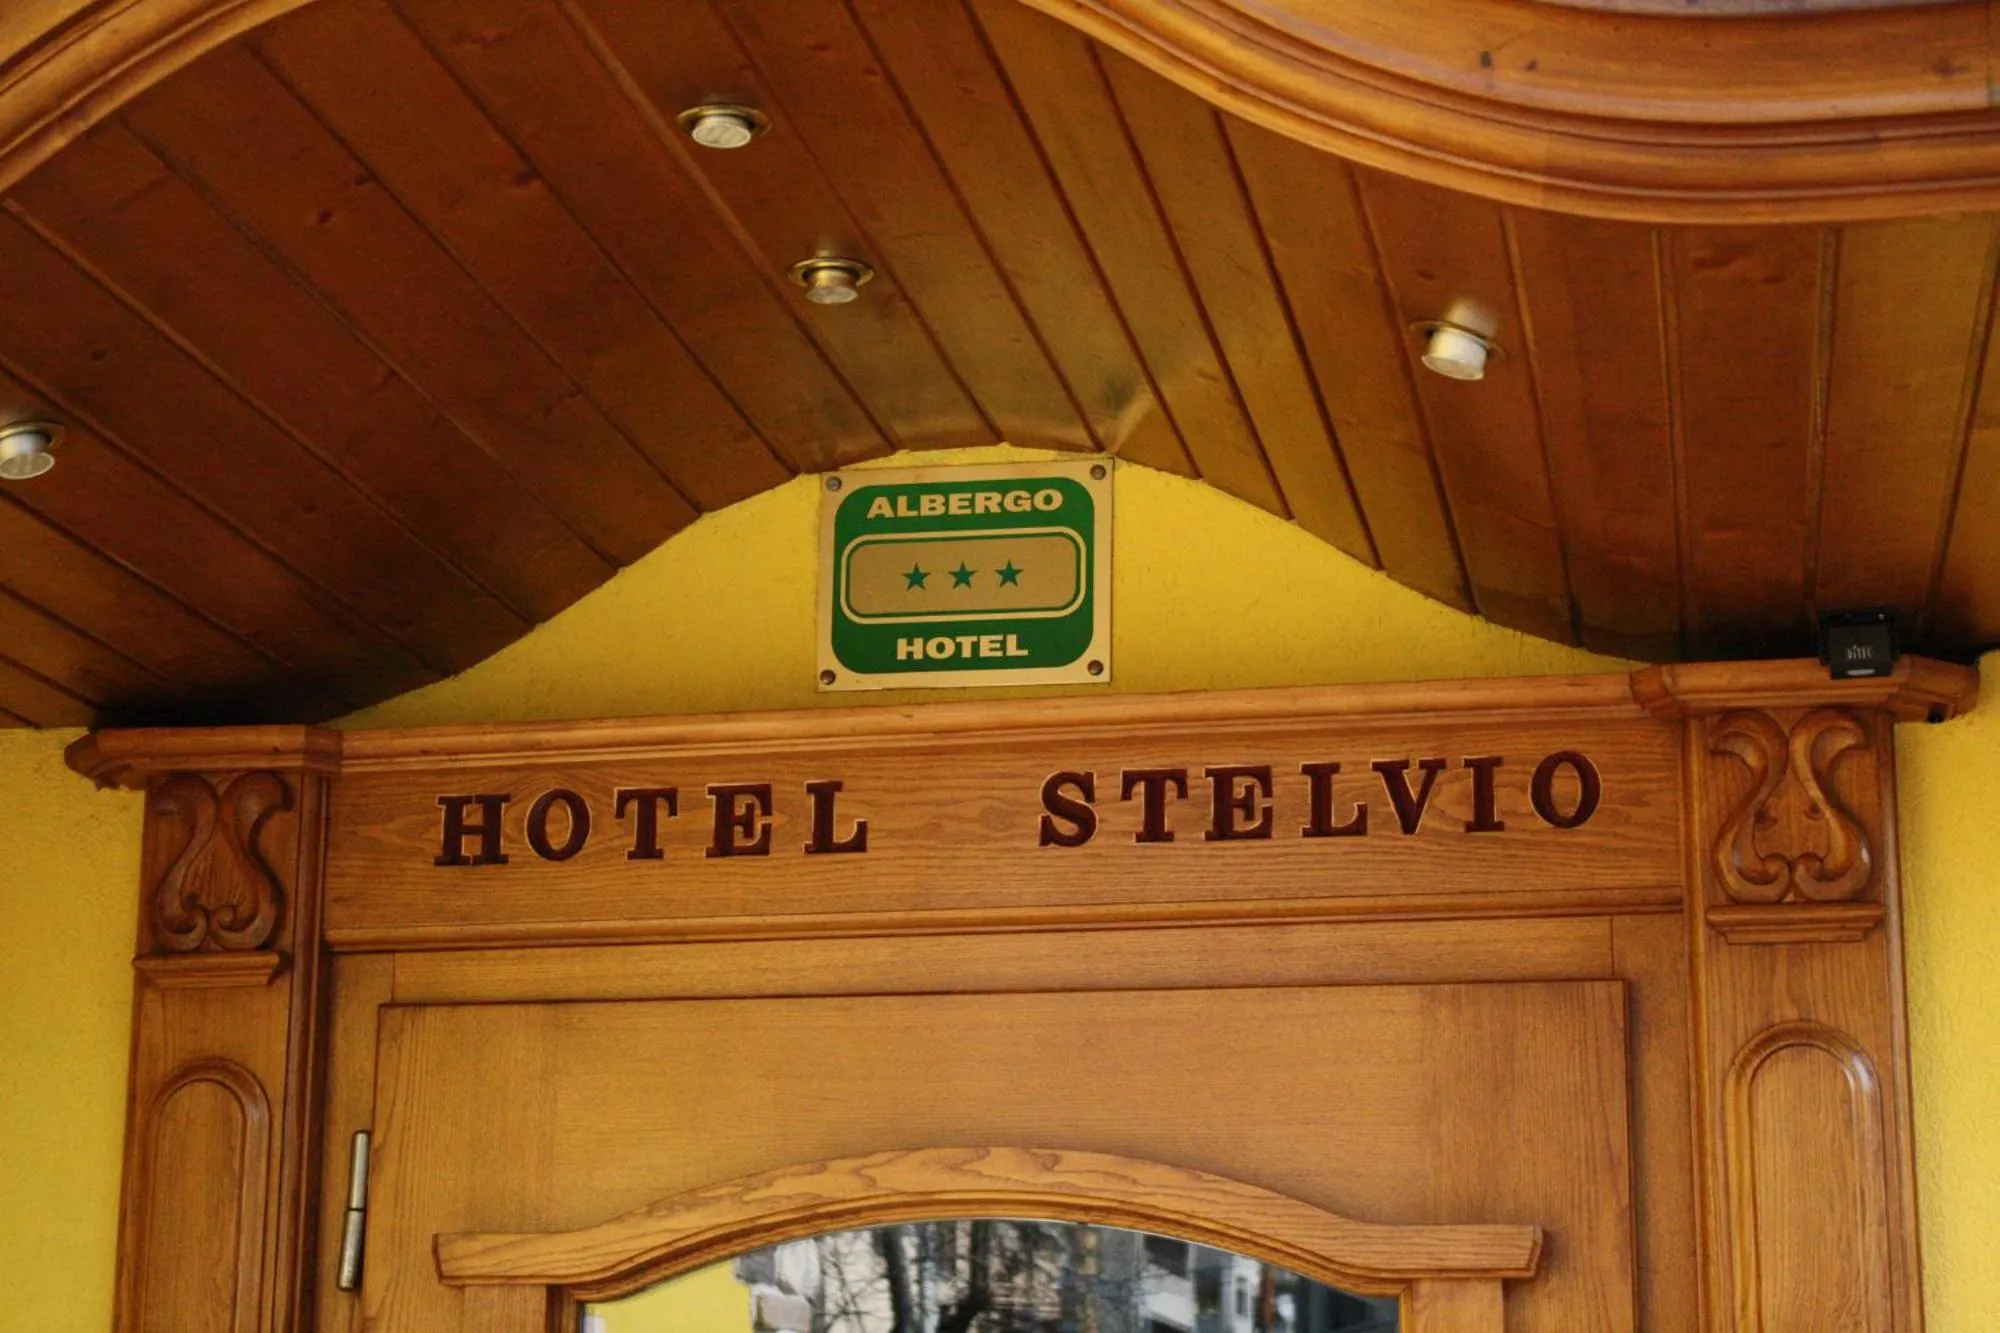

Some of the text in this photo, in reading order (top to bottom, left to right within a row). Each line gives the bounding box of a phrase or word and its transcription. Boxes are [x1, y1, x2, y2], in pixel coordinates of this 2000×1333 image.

[866, 489, 1063, 519] ALBERGO
[896, 634, 1028, 660] HOTEL
[434, 750, 1601, 866] HOTEL STELVIO
